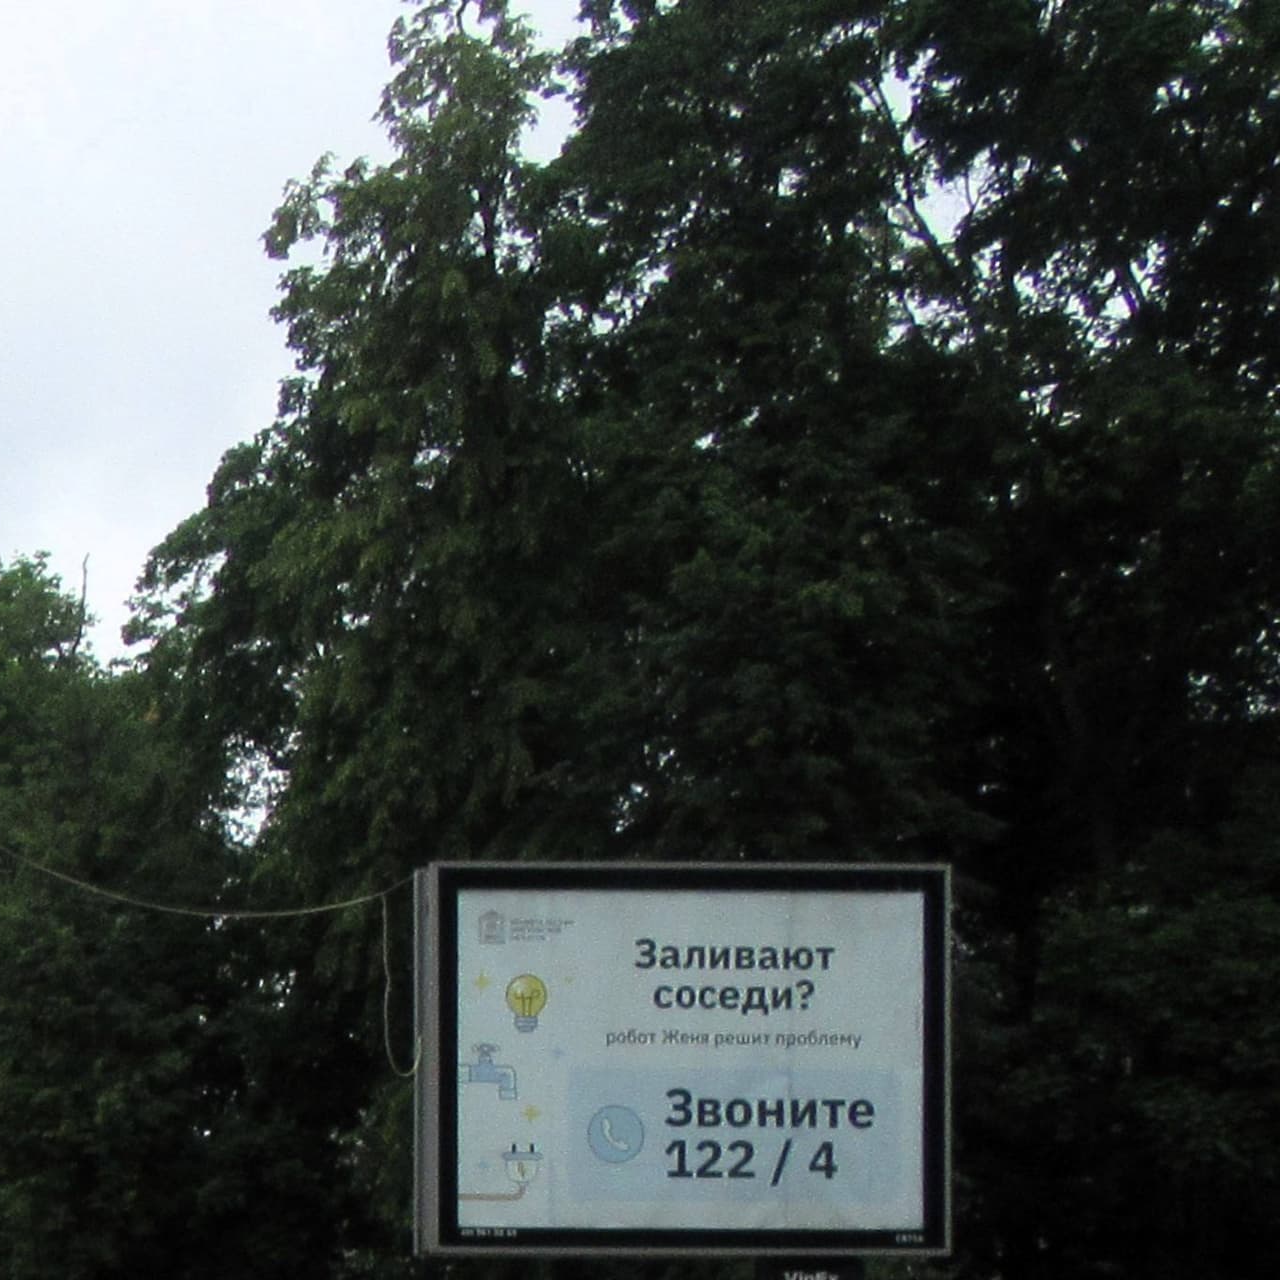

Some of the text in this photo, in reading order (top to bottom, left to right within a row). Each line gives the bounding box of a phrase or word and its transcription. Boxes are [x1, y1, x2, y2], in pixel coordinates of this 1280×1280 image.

[634, 938, 835, 972] Заливают
[652, 980, 816, 1015] соседи?
[605, 1029, 862, 1048] робот Женя решит проблему
[664, 1088, 876, 1129] Звоните
[665, 1140, 756, 1179] 122
[809, 1142, 838, 1179] 4
